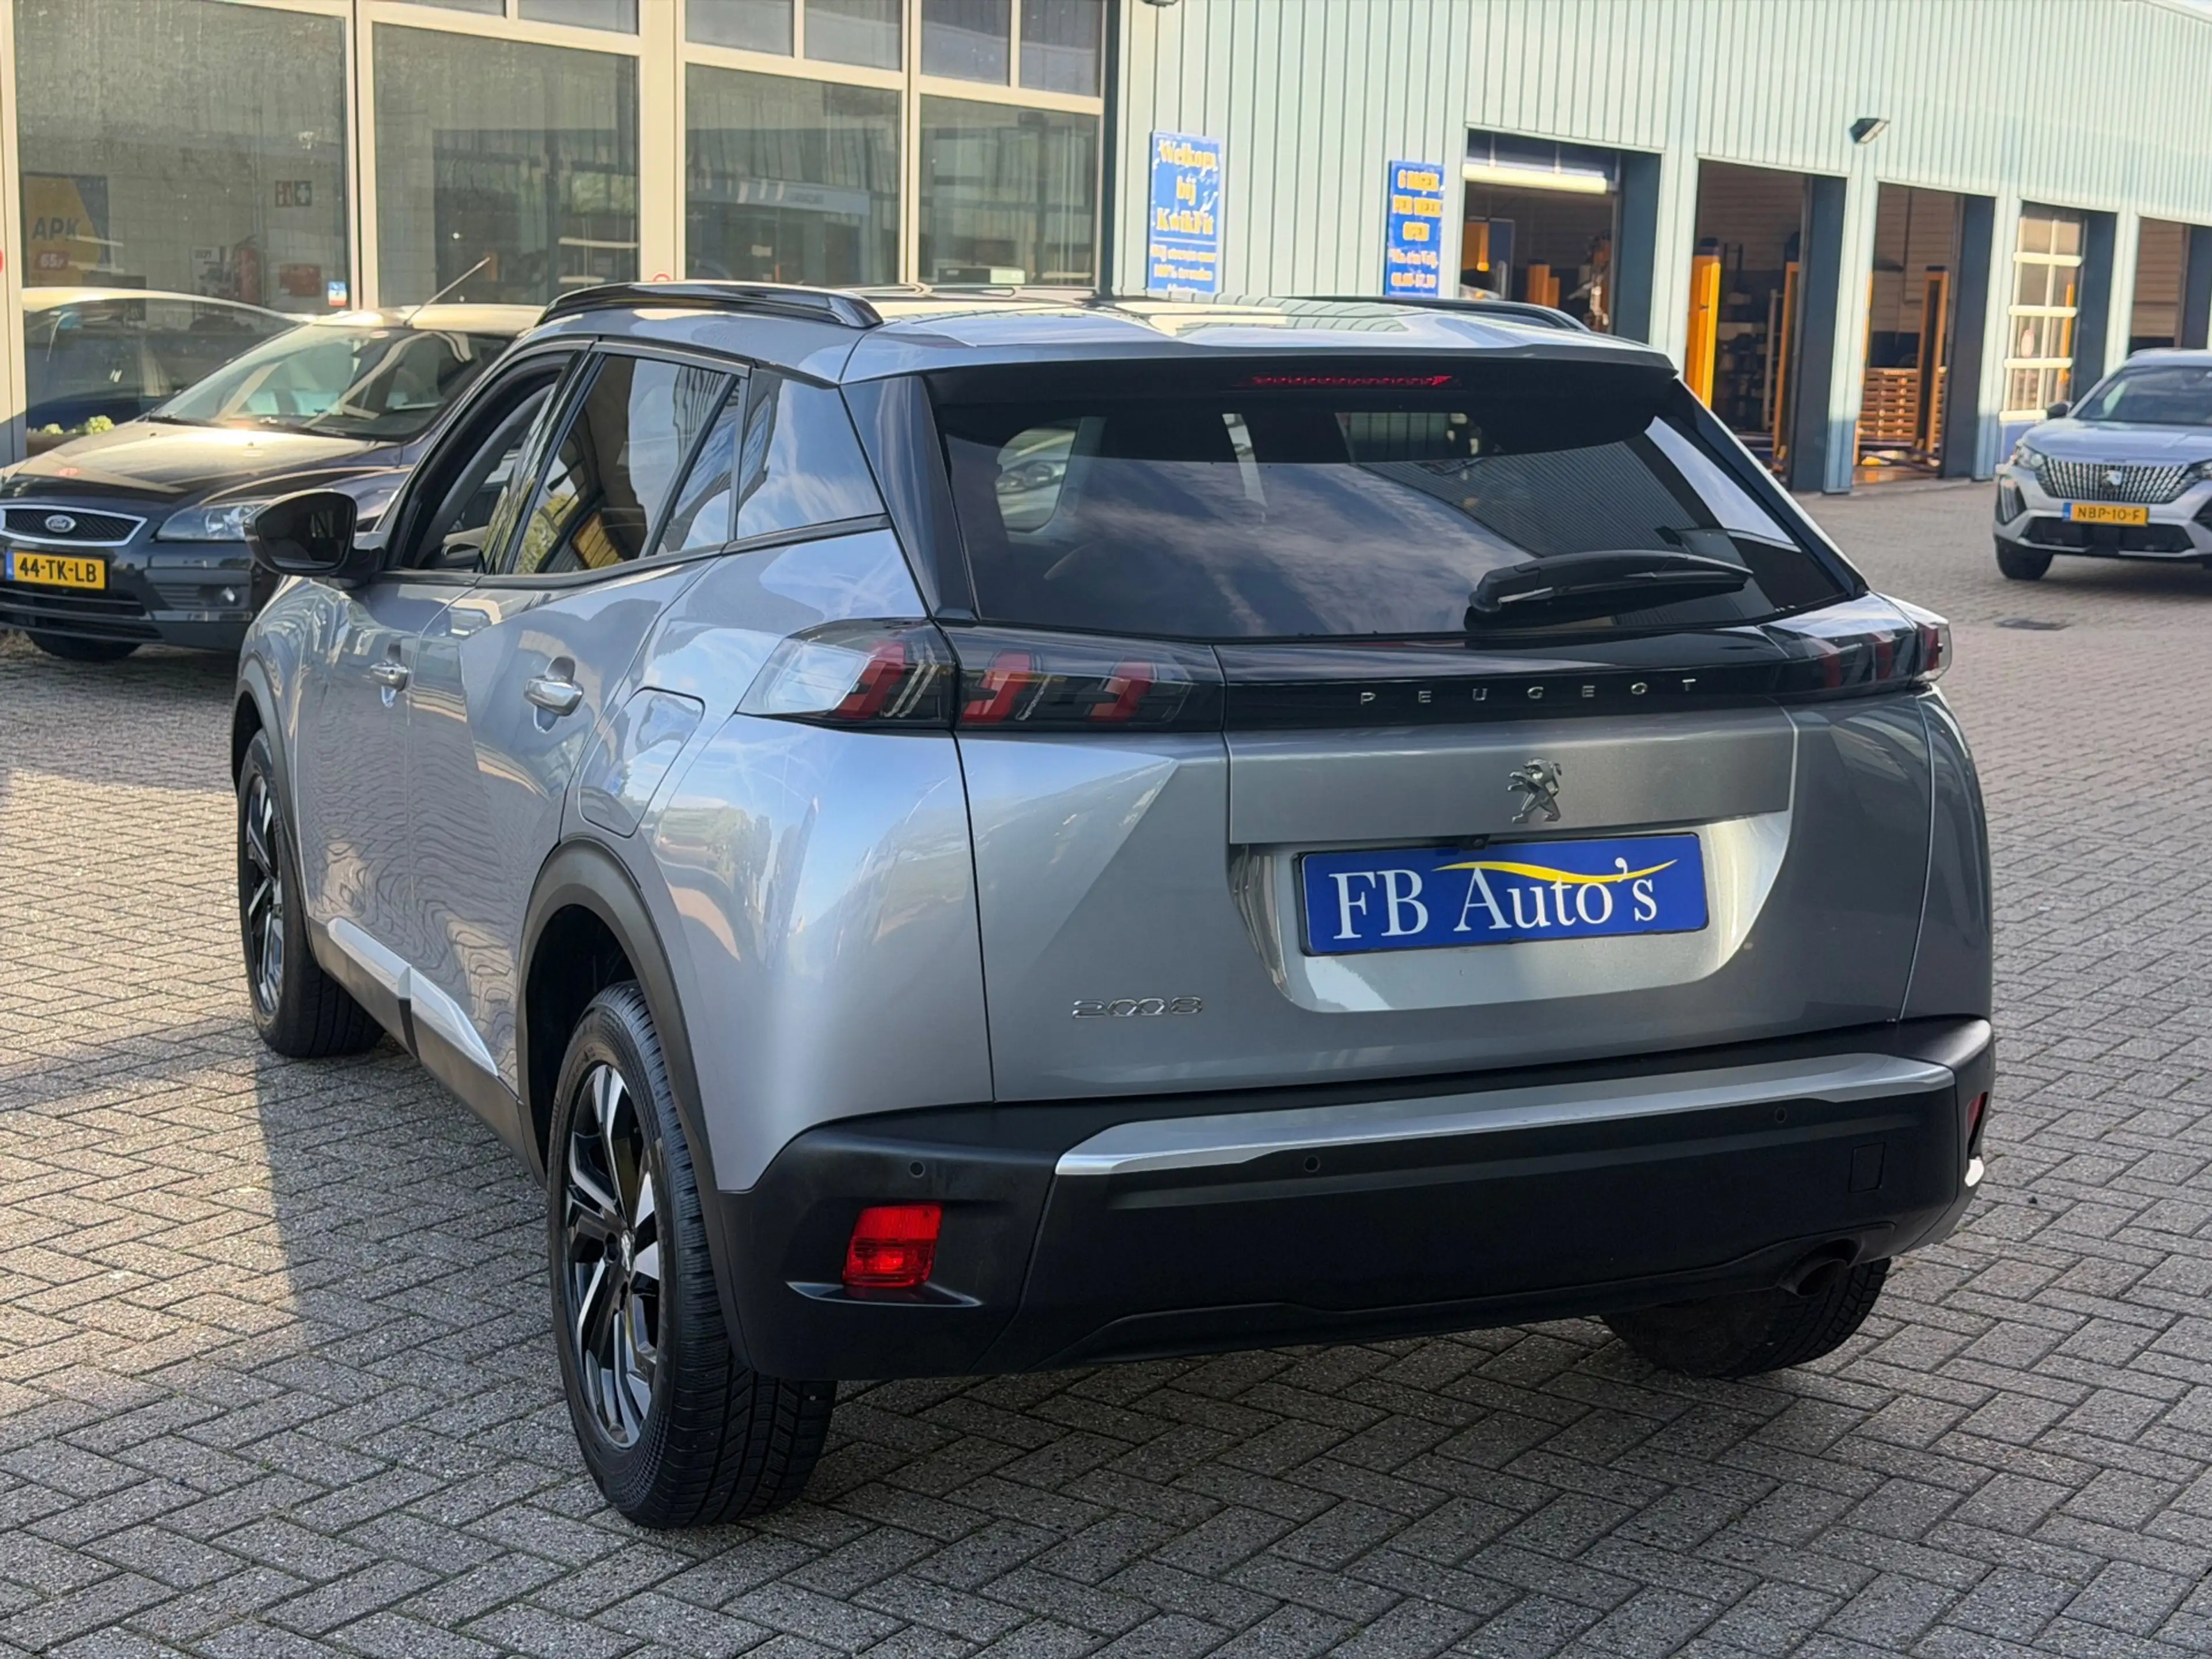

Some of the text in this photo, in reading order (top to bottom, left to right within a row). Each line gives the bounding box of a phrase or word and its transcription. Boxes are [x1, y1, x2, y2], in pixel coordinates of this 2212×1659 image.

[1176, 176, 1196, 206] bij
[32, 217, 80, 241] APK
[2077, 507, 2141, 521] NBP-10-F
[19, 556, 97, 583] 44-TK-LB
[1360, 679, 1697, 704] PEUGEOT
[1329, 857, 1658, 940] FB Auto's
[1072, 997, 1203, 1018] 2008
